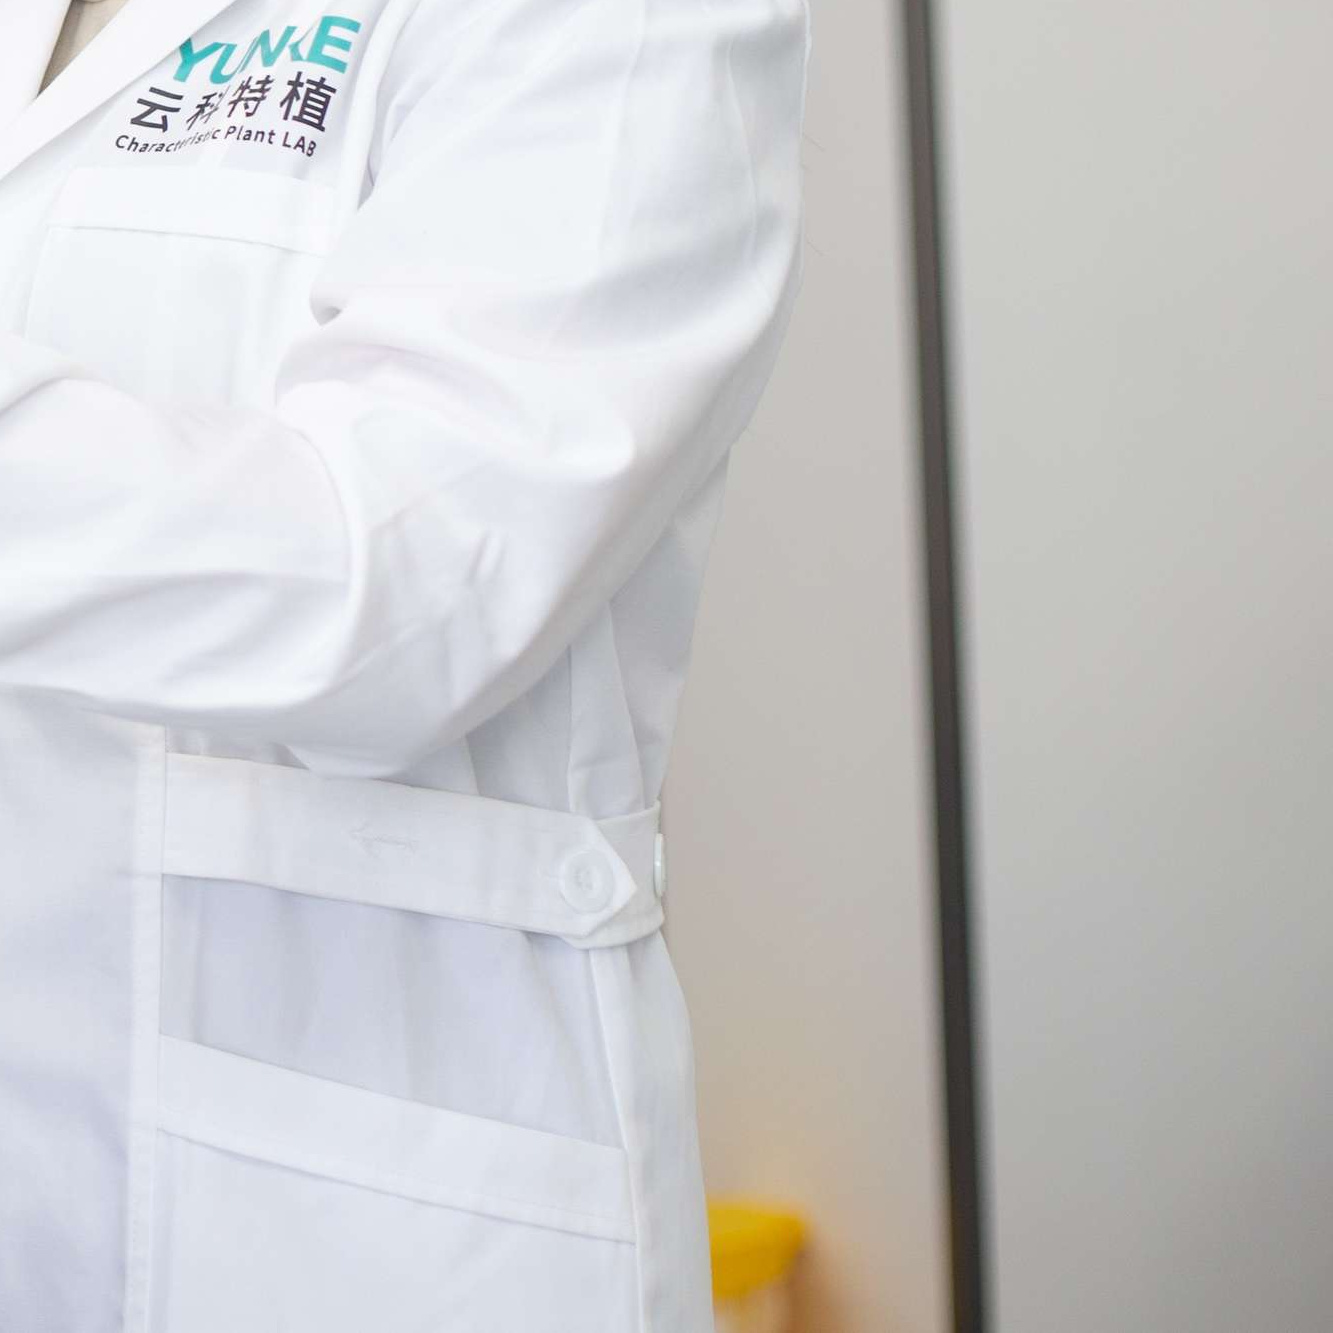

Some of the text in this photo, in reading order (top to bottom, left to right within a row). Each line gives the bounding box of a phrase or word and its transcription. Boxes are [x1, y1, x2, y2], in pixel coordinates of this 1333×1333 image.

[130, 71, 337, 132] 云科特植
[224, 125, 276, 145] Plant
[282, 131, 317, 157] LAB
